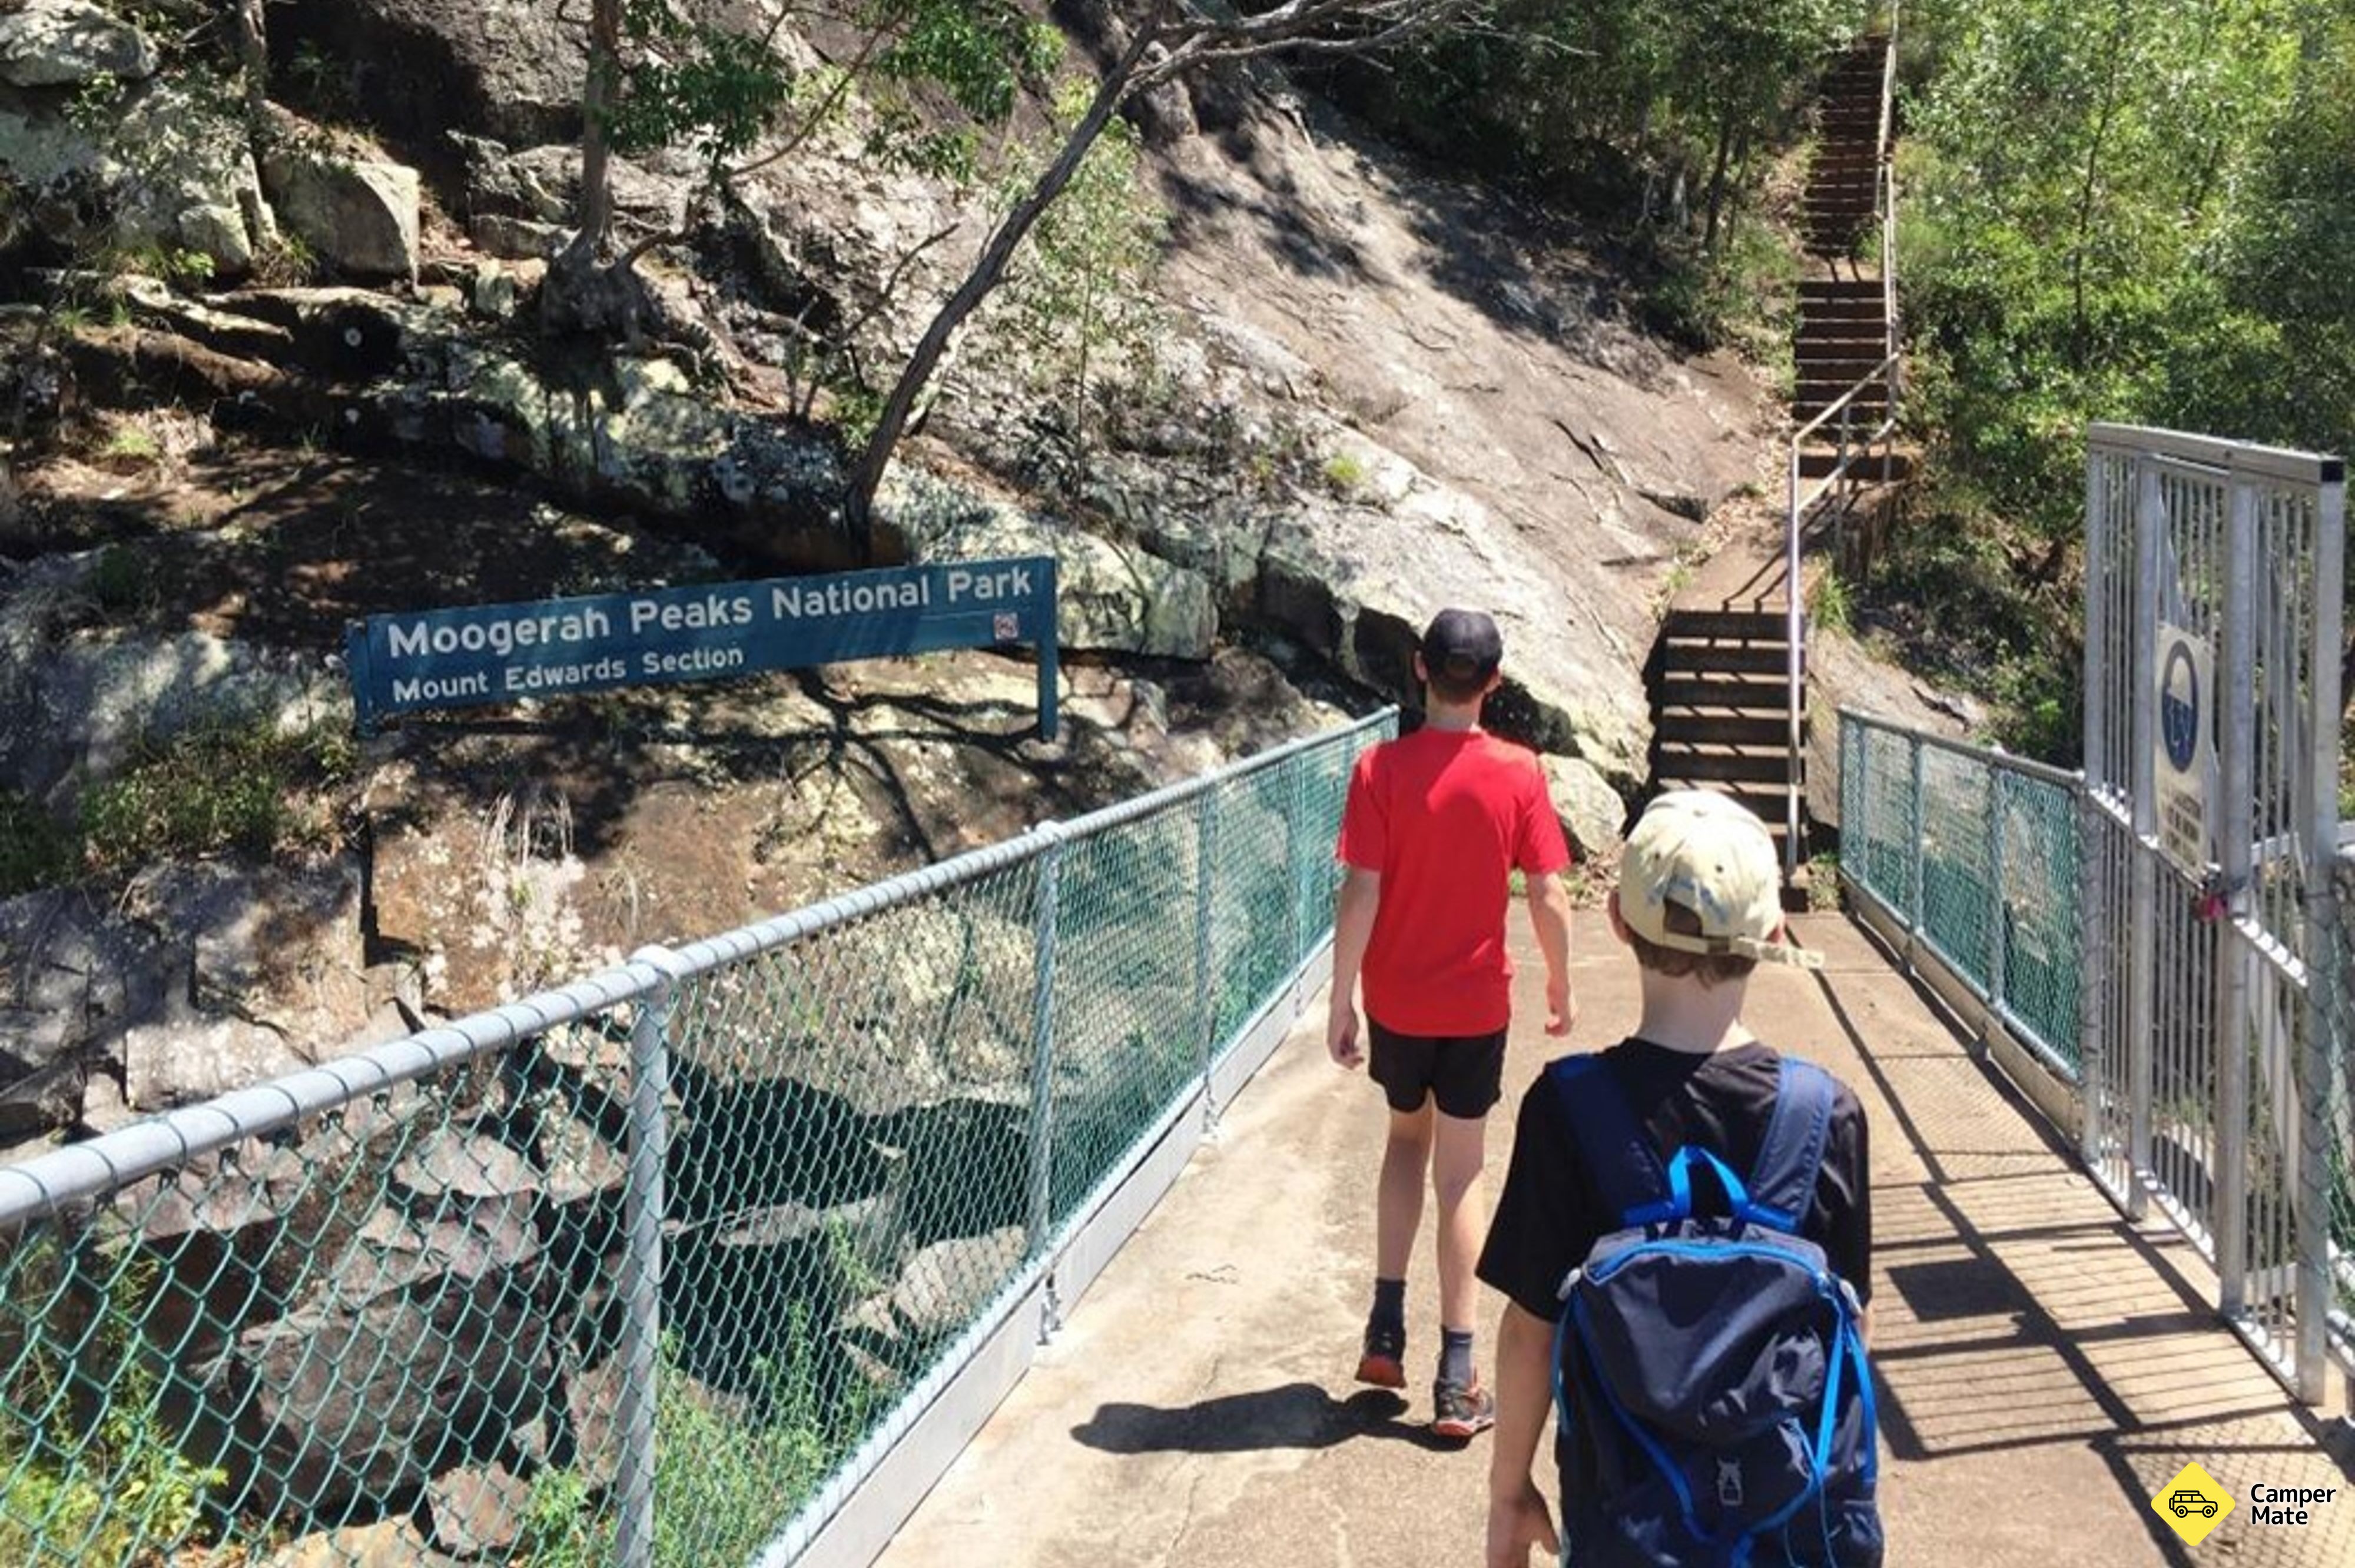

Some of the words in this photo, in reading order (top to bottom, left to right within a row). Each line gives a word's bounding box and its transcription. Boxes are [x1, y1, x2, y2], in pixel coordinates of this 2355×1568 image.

[388, 607, 609, 659] Moogerah
[631, 594, 753, 634] Peaks
[772, 574, 930, 619] National
[948, 566, 1032, 602] Park
[393, 672, 488, 703] Mount
[506, 658, 626, 691] Edwards
[643, 644, 744, 673] Section
